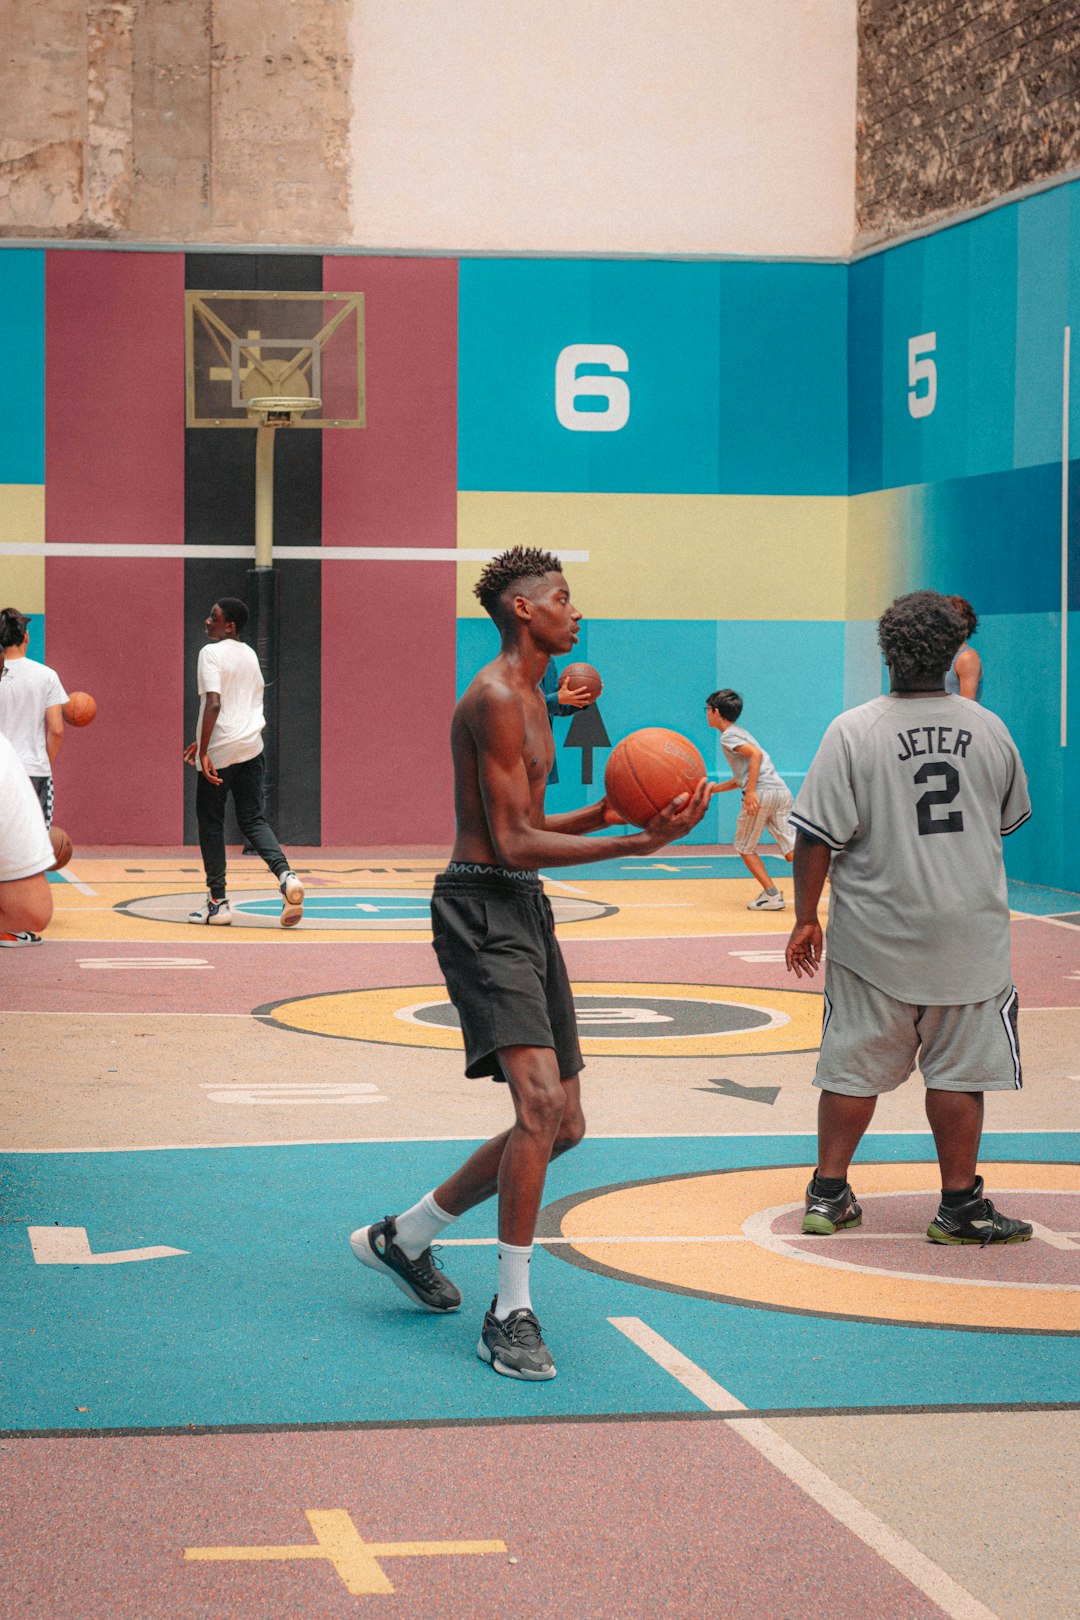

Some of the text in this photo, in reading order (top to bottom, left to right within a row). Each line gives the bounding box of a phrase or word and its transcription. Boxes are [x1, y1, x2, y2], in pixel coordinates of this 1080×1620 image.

[555, 343, 631, 432] 6
[908, 331, 938, 419] 5
[897, 726, 973, 761] JETER
[913, 761, 964, 836] 2
